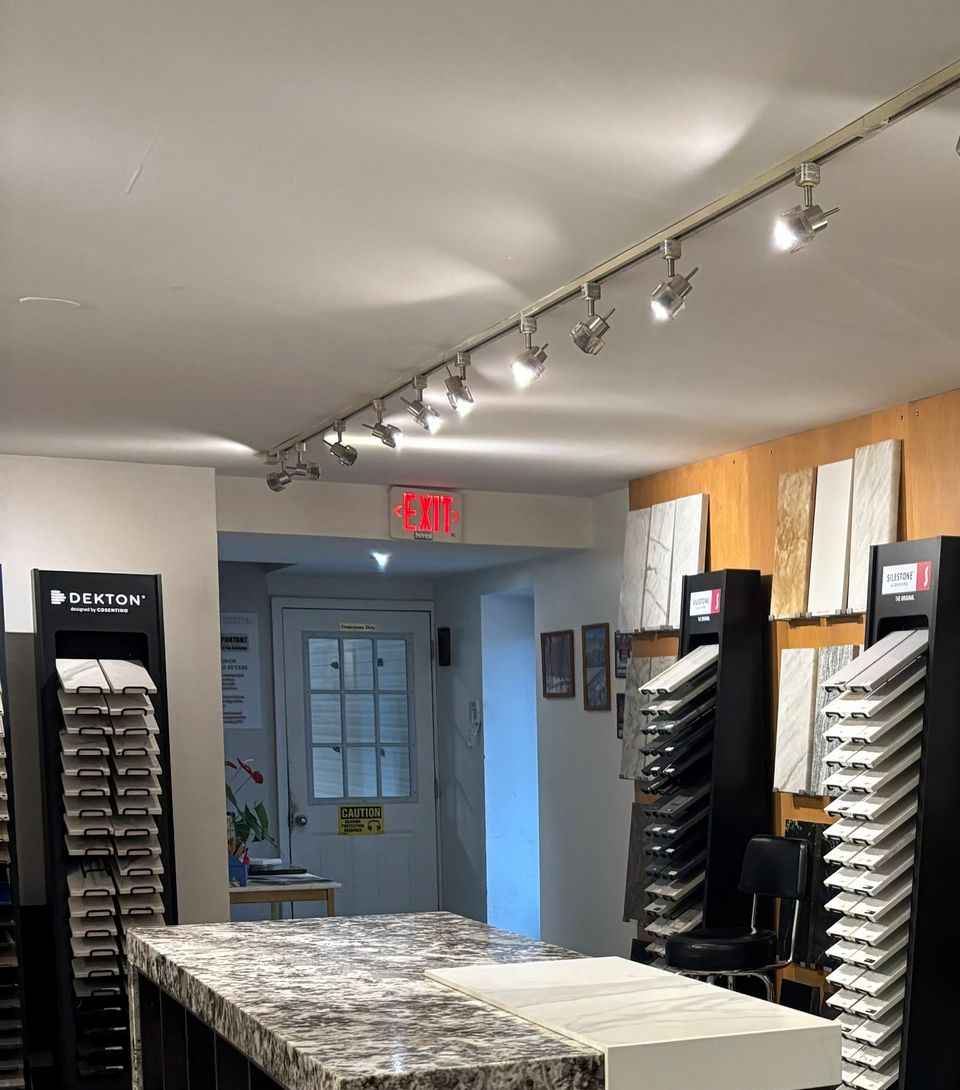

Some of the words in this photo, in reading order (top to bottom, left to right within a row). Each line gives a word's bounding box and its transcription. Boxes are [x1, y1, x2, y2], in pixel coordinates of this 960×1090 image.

[403, 493, 454, 534] EXIT
[887, 571, 913, 582] SILESTONE
[69, 592, 140, 606] DEKTON
[342, 807, 381, 818] CAUTION
